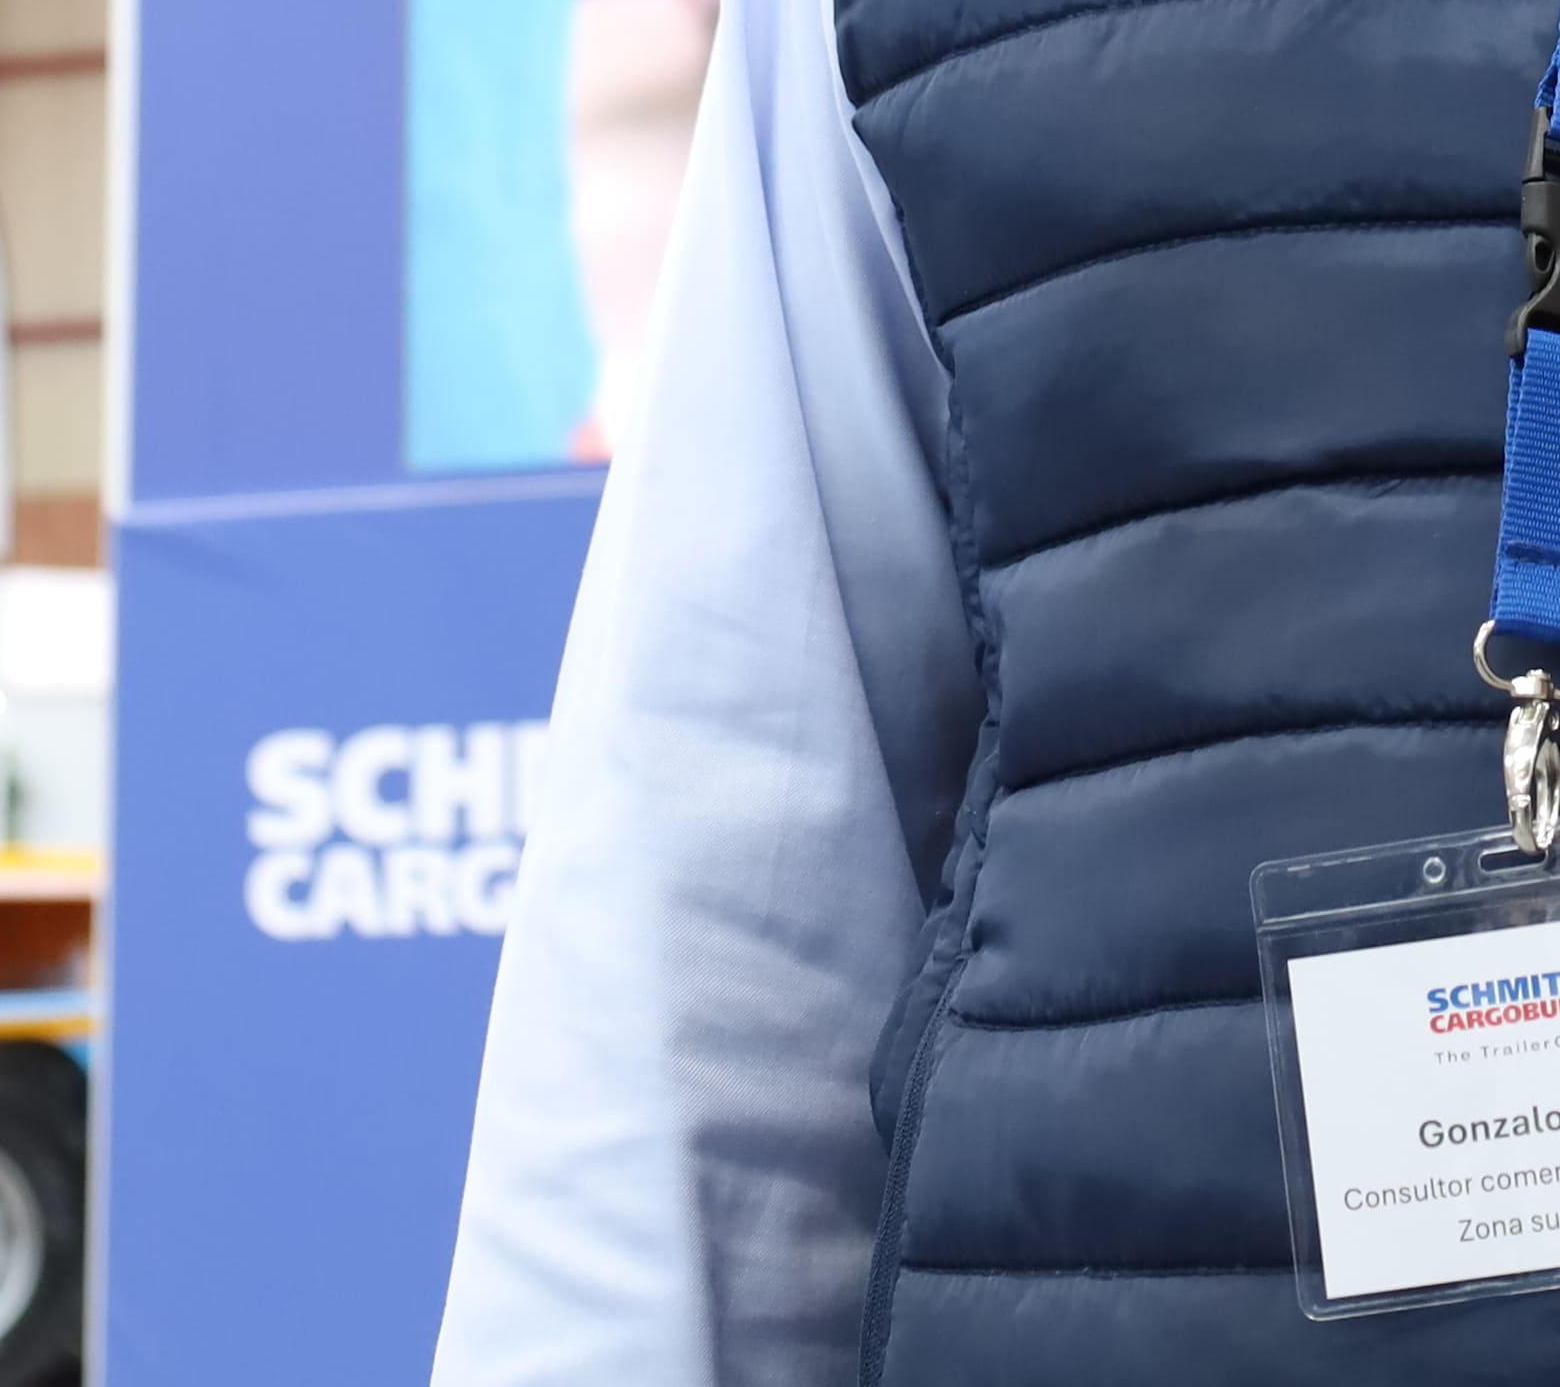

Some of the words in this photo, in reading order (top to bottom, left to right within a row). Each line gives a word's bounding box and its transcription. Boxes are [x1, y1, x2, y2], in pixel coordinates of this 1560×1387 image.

[1434, 1049, 1472, 1065] The
[1343, 1176, 1474, 1212] Consultor
[1458, 1215, 1524, 1243] Zona
